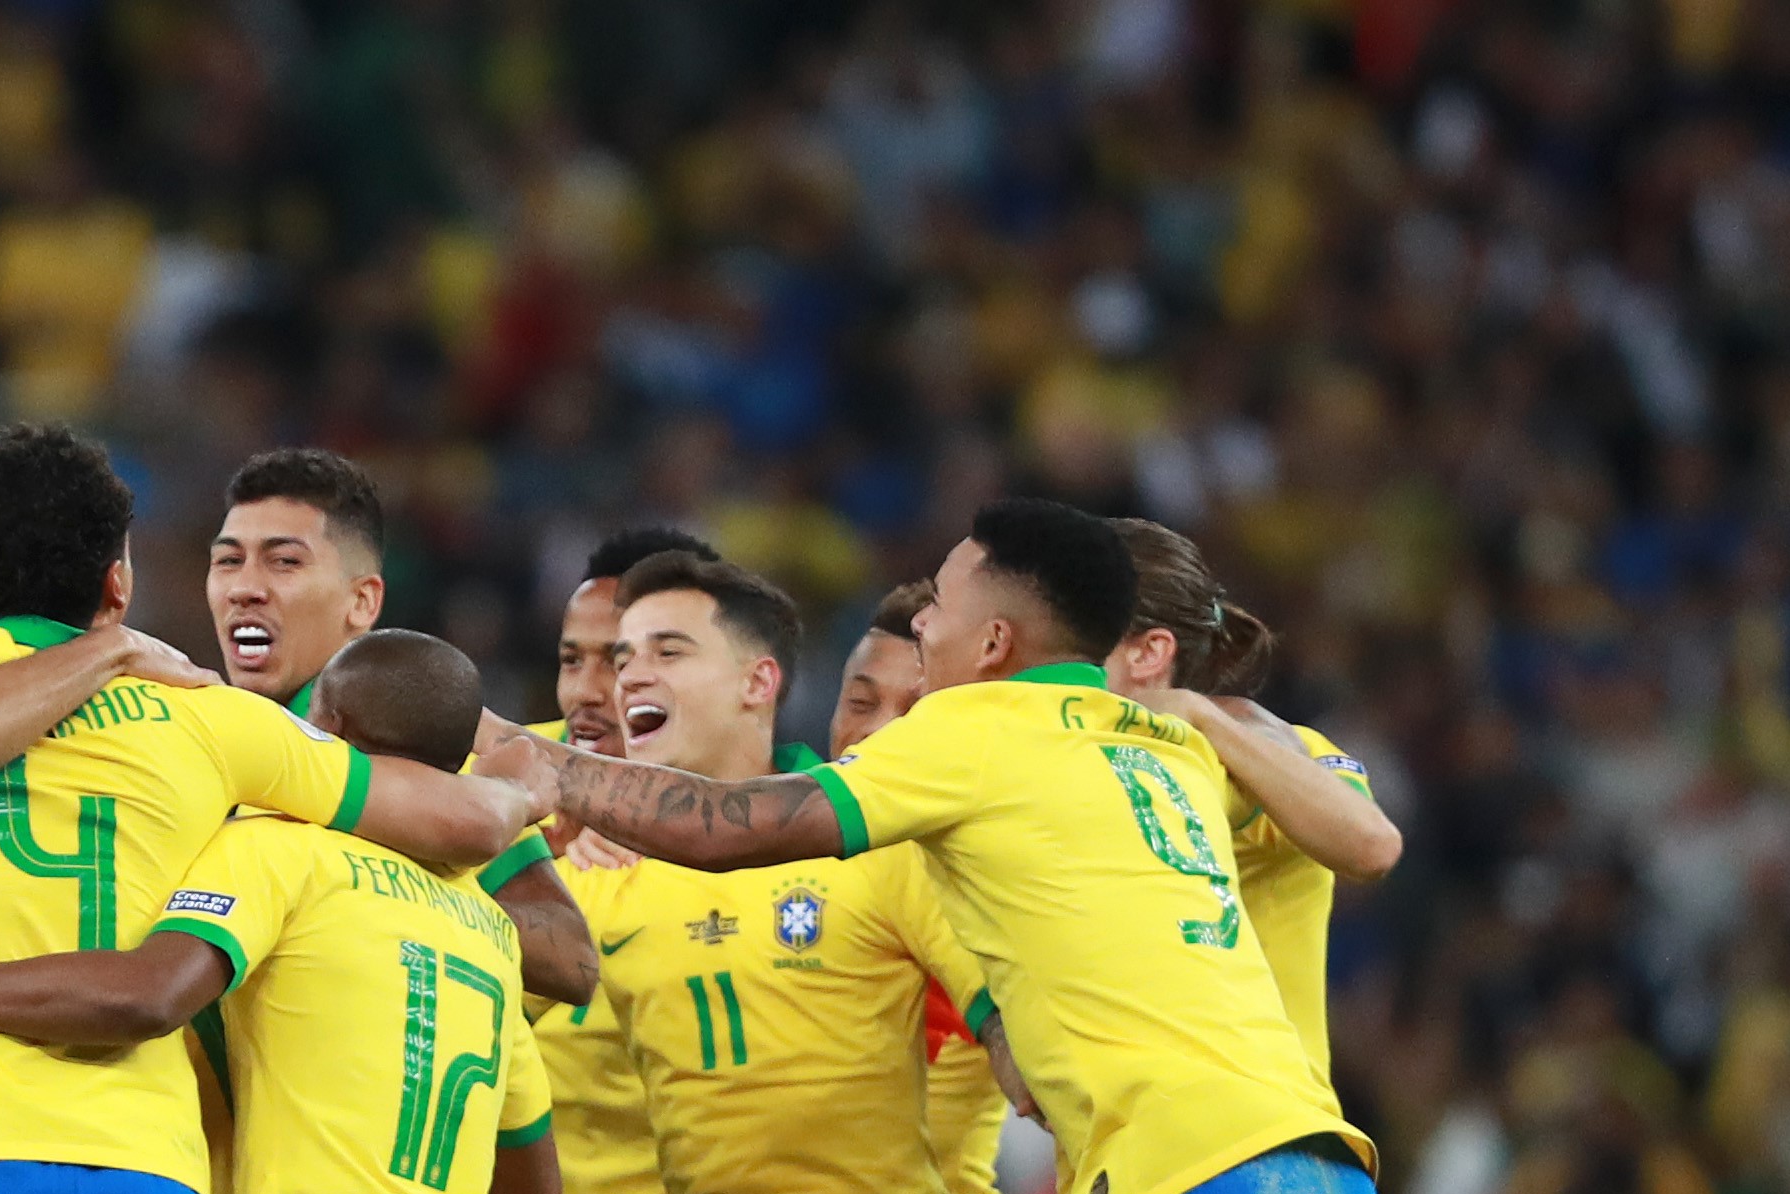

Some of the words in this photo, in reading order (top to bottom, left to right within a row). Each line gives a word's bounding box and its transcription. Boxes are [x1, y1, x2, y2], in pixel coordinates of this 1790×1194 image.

[174, 891, 210, 902] Cree
[211, 896, 230, 906] en
[1099, 744, 1241, 950] 9
[170, 900, 224, 912] grande
[342, 850, 515, 964] FERNANDINHO
[389, 938, 505, 1191] 17
[685, 970, 748, 1071] 11
